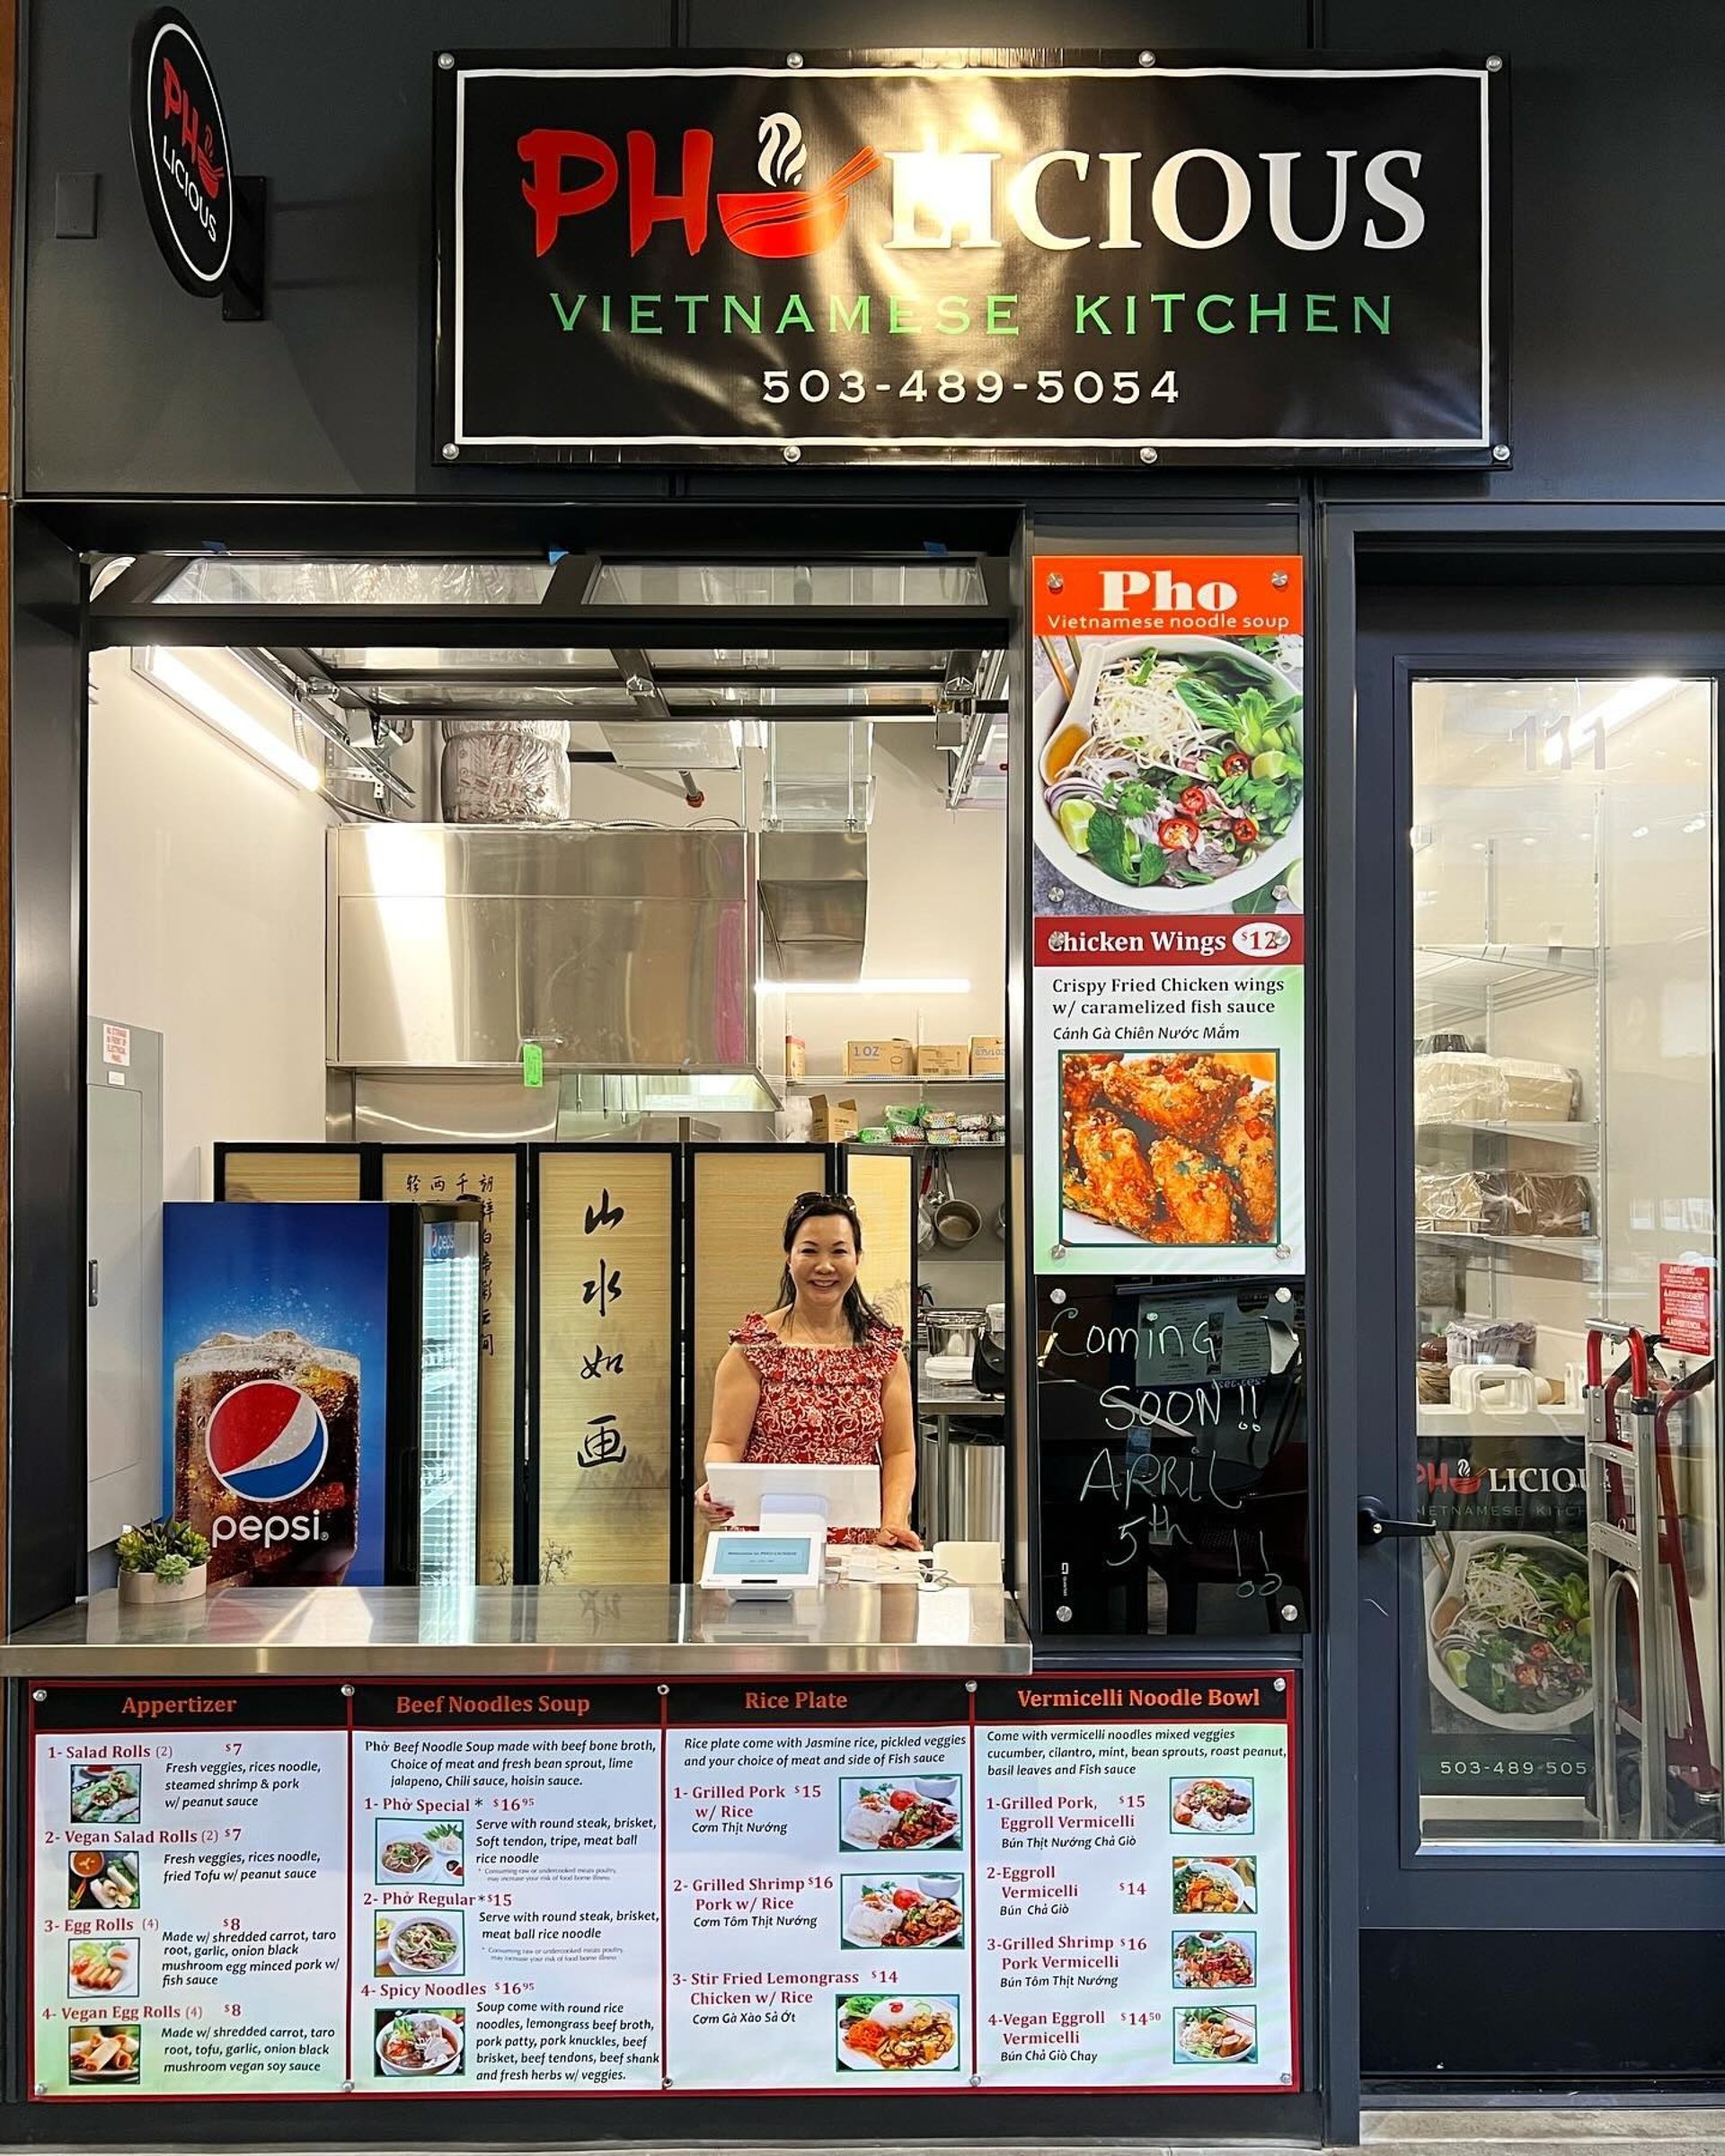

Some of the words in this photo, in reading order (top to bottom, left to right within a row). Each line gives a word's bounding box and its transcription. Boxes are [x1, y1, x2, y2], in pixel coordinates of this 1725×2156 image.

[164, 136, 217, 243] LICIOUS
[883, 147, 1426, 252] LICIOUS
[552, 293, 1016, 335] VIETNAMESE
[1075, 293, 1392, 335] KITCHEN
[1101, 571, 1237, 611] Pho
[1048, 615, 1164, 629] Vietnamese
[1171, 614, 1236, 628] noodle
[1243, 617, 1289, 632] soup
[1509, 716, 1606, 770] 111
[1150, 932, 1225, 956] Wings
[1053, 979, 1106, 996] Crispy
[1112, 978, 1155, 992] Fried
[1162, 978, 1228, 992] Chicken
[1234, 977, 1284, 994] wings
[1053, 1001, 1075, 1018] w/
[1082, 1000, 1185, 1014] caramelized
[1191, 1000, 1221, 1013] fish
[1227, 1003, 1275, 1012] sauce
[854, 1047, 859, 1056] 1
[863, 1047, 880, 1056] OZ
[746, 1692, 789, 1709] Rice
[796, 1692, 847, 1709] Plate
[1018, 1689, 1123, 1707] Vermicelli
[1129, 1689, 1202, 1706] Noodle
[1208, 1689, 1260, 1706] Bowl
[122, 1696, 237, 1719] Appertizer
[397, 1696, 445, 1713] Beef
[449, 1696, 533, 1712] Noodles
[539, 1696, 589, 1717] Soup
[66, 1746, 107, 1758] Salad
[113, 1745, 150, 1758] Rolls
[156, 1746, 172, 1758] (2)
[394, 1741, 420, 1754] Beef
[422, 1742, 463, 1752] Noodle
[465, 1742, 494, 1754] Soup
[498, 1741, 529, 1752] made
[533, 1741, 558, 1751] with
[562, 1740, 587, 1754] beef
[589, 1741, 618, 1751] bone
[622, 1740, 656, 1753] broth,
[166, 1763, 197, 1773] Fresh
[200, 1762, 246, 1775] veggies,
[250, 1762, 275, 1772] rices
[279, 1761, 321, 1773] noodle,
[694, 1786, 744, 1798] Grilled
[750, 1786, 785, 1798] Pork
[417, 1799, 469, 1815] Special
[1058, 1797, 1097, 1810] Pork,
[695, 1806, 716, 1821] w/
[722, 1806, 753, 1817] Rice
[1002, 1816, 1053, 1833] Eggroll
[1058, 1815, 1134, 1828] Vermicelli
[65, 1831, 110, 1846] Vegan
[115, 1831, 154, 1843] Salad
[160, 1830, 198, 1842] Rolls
[202, 1831, 218, 1842] (2)
[694, 1878, 744, 1891] Grilled
[749, 1878, 804, 1893] Shrimp
[1003, 1885, 1077, 1898] Vermicelli
[697, 1898, 732, 1911] Pork
[737, 1897, 757, 1913] w/
[763, 1897, 793, 1909] Rice
[65, 1920, 91, 1935] Egg
[96, 1918, 133, 1931] Rolls
[143, 1919, 158, 1931] (4)
[1058, 1936, 1113, 1951] Shrimp
[1003, 1957, 1038, 1970] Pork
[1042, 1956, 1119, 1968] Vermicelli
[692, 1973, 719, 1985] Stir
[724, 1973, 762, 1984] Fried
[767, 1973, 859, 1986] Lemongrass
[381, 1984, 420, 2000] Spicy
[426, 1983, 486, 1995] Noodles
[691, 1992, 750, 2005] Chicken
[756, 1992, 776, 2007] w/
[782, 1992, 813, 2003] Rice
[62, 2008, 107, 2022] Vegan
[113, 2006, 139, 2021] Egg
[144, 2005, 181, 2018] Rolls
[187, 2008, 202, 2019] (4)
[1053, 2011, 1104, 2027] Eggroll
[1004, 2031, 1079, 2045] Vermicelli
[476, 2070, 498, 2081] and
[500, 2070, 528, 2082] fresh
[532, 2070, 562, 2080] herbs
[565, 2070, 579, 2081] w/
[582, 2070, 626, 2083] veggies.
